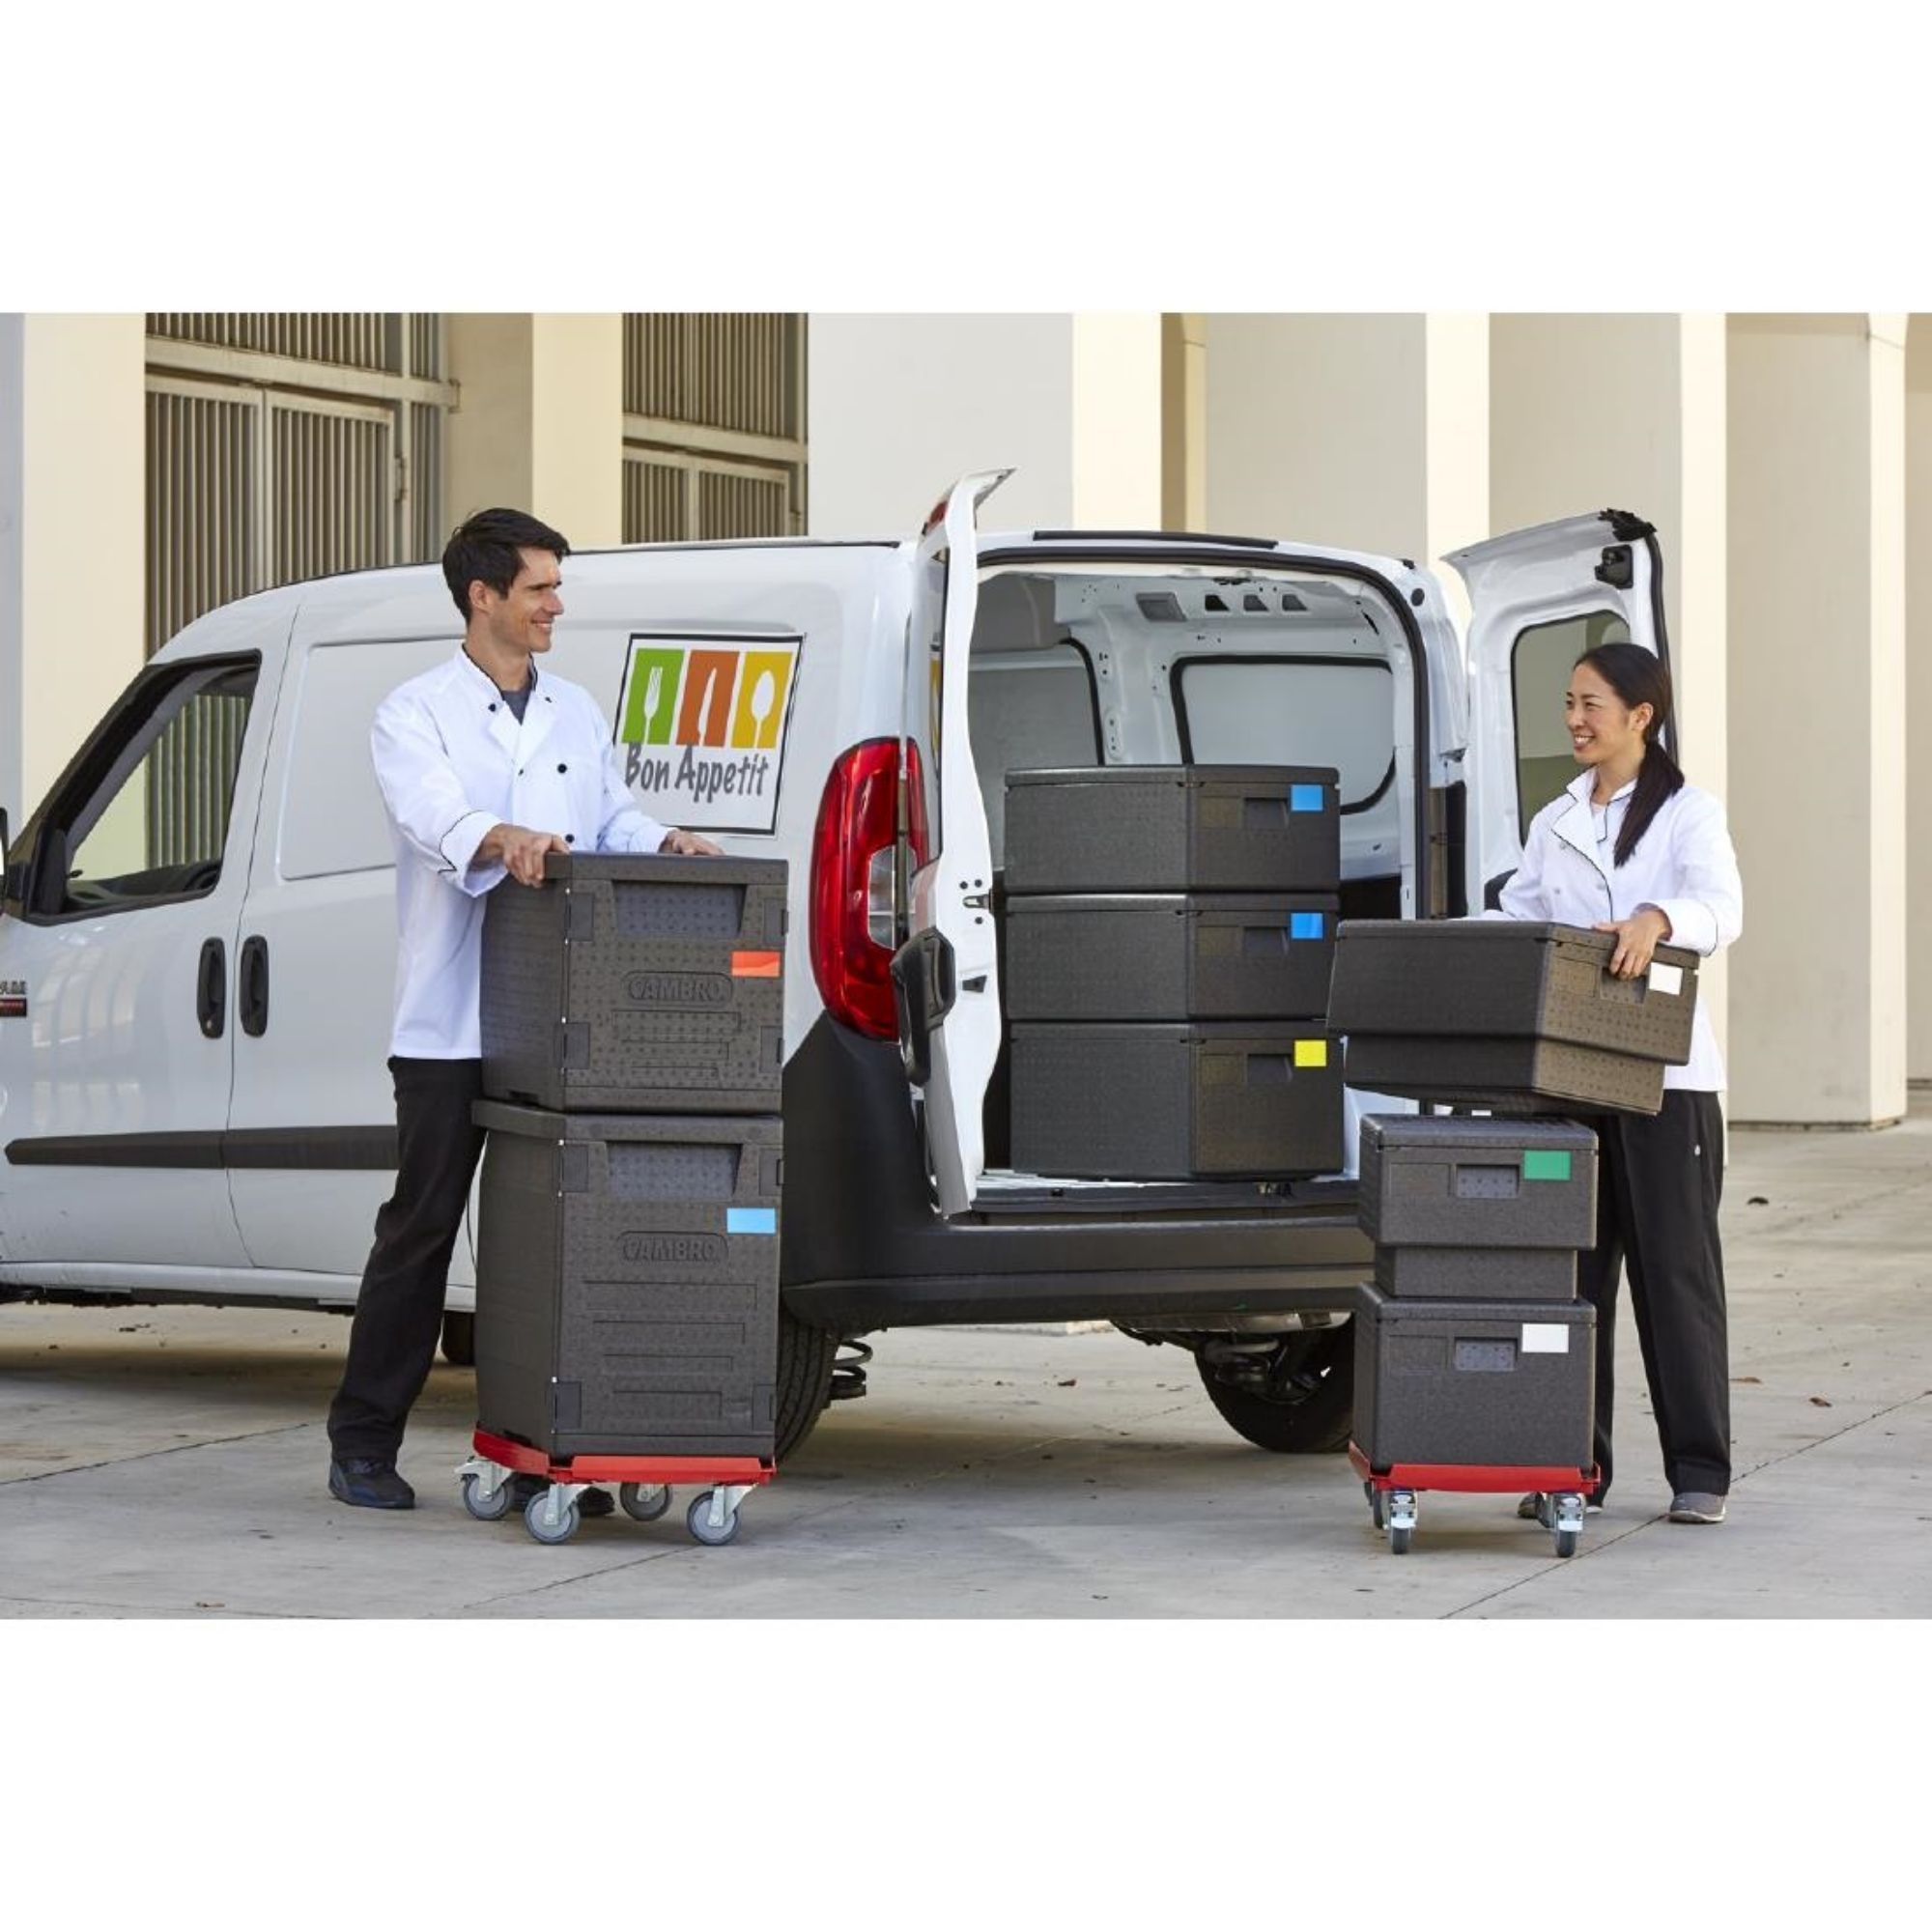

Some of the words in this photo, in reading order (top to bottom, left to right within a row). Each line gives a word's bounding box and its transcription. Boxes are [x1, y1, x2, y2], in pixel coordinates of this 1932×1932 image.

[625, 742, 669, 792] Bon
[674, 744, 769, 804] Appetit
[629, 978, 726, 1002] CAMBRO
[623, 1237, 719, 1262] CAMBRO
